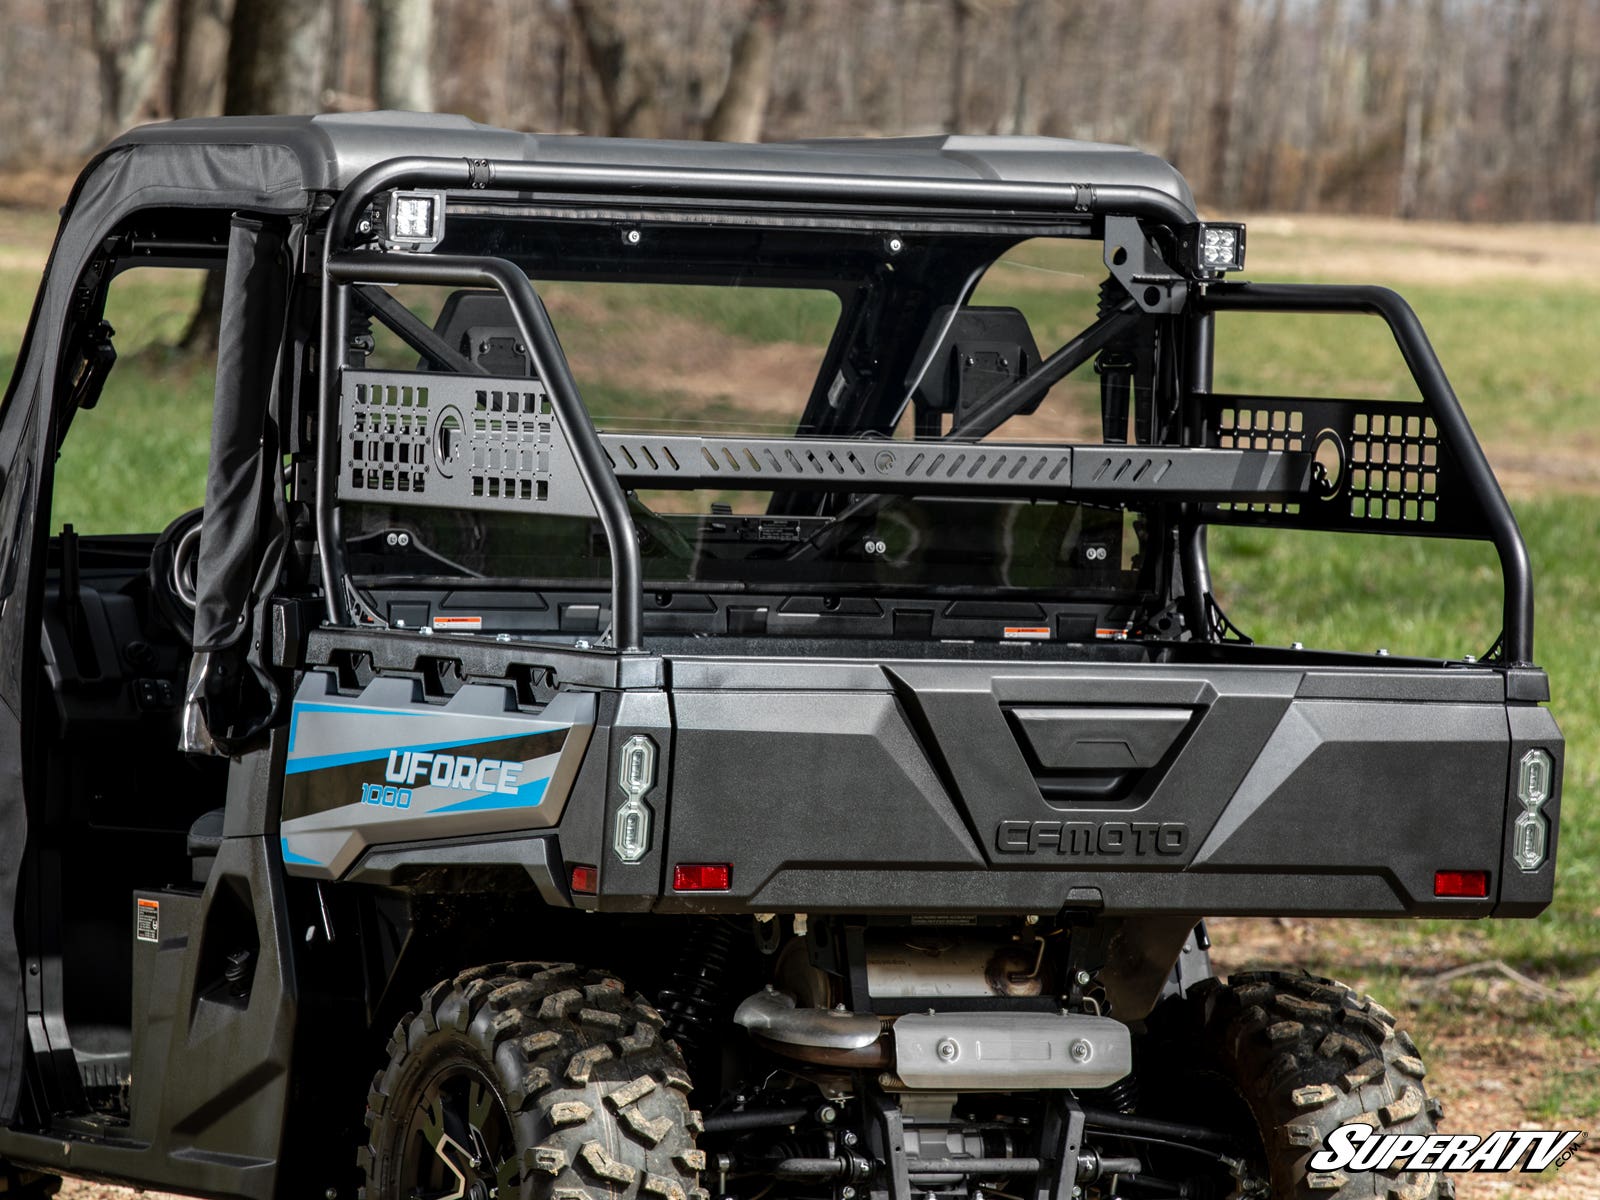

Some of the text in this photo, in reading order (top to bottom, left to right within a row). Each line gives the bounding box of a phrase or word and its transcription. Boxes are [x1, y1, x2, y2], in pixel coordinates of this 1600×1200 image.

[385, 750, 524, 795] UFORCE
[361, 783, 412, 809] 1000
[995, 820, 1190, 855] CFMOTO
